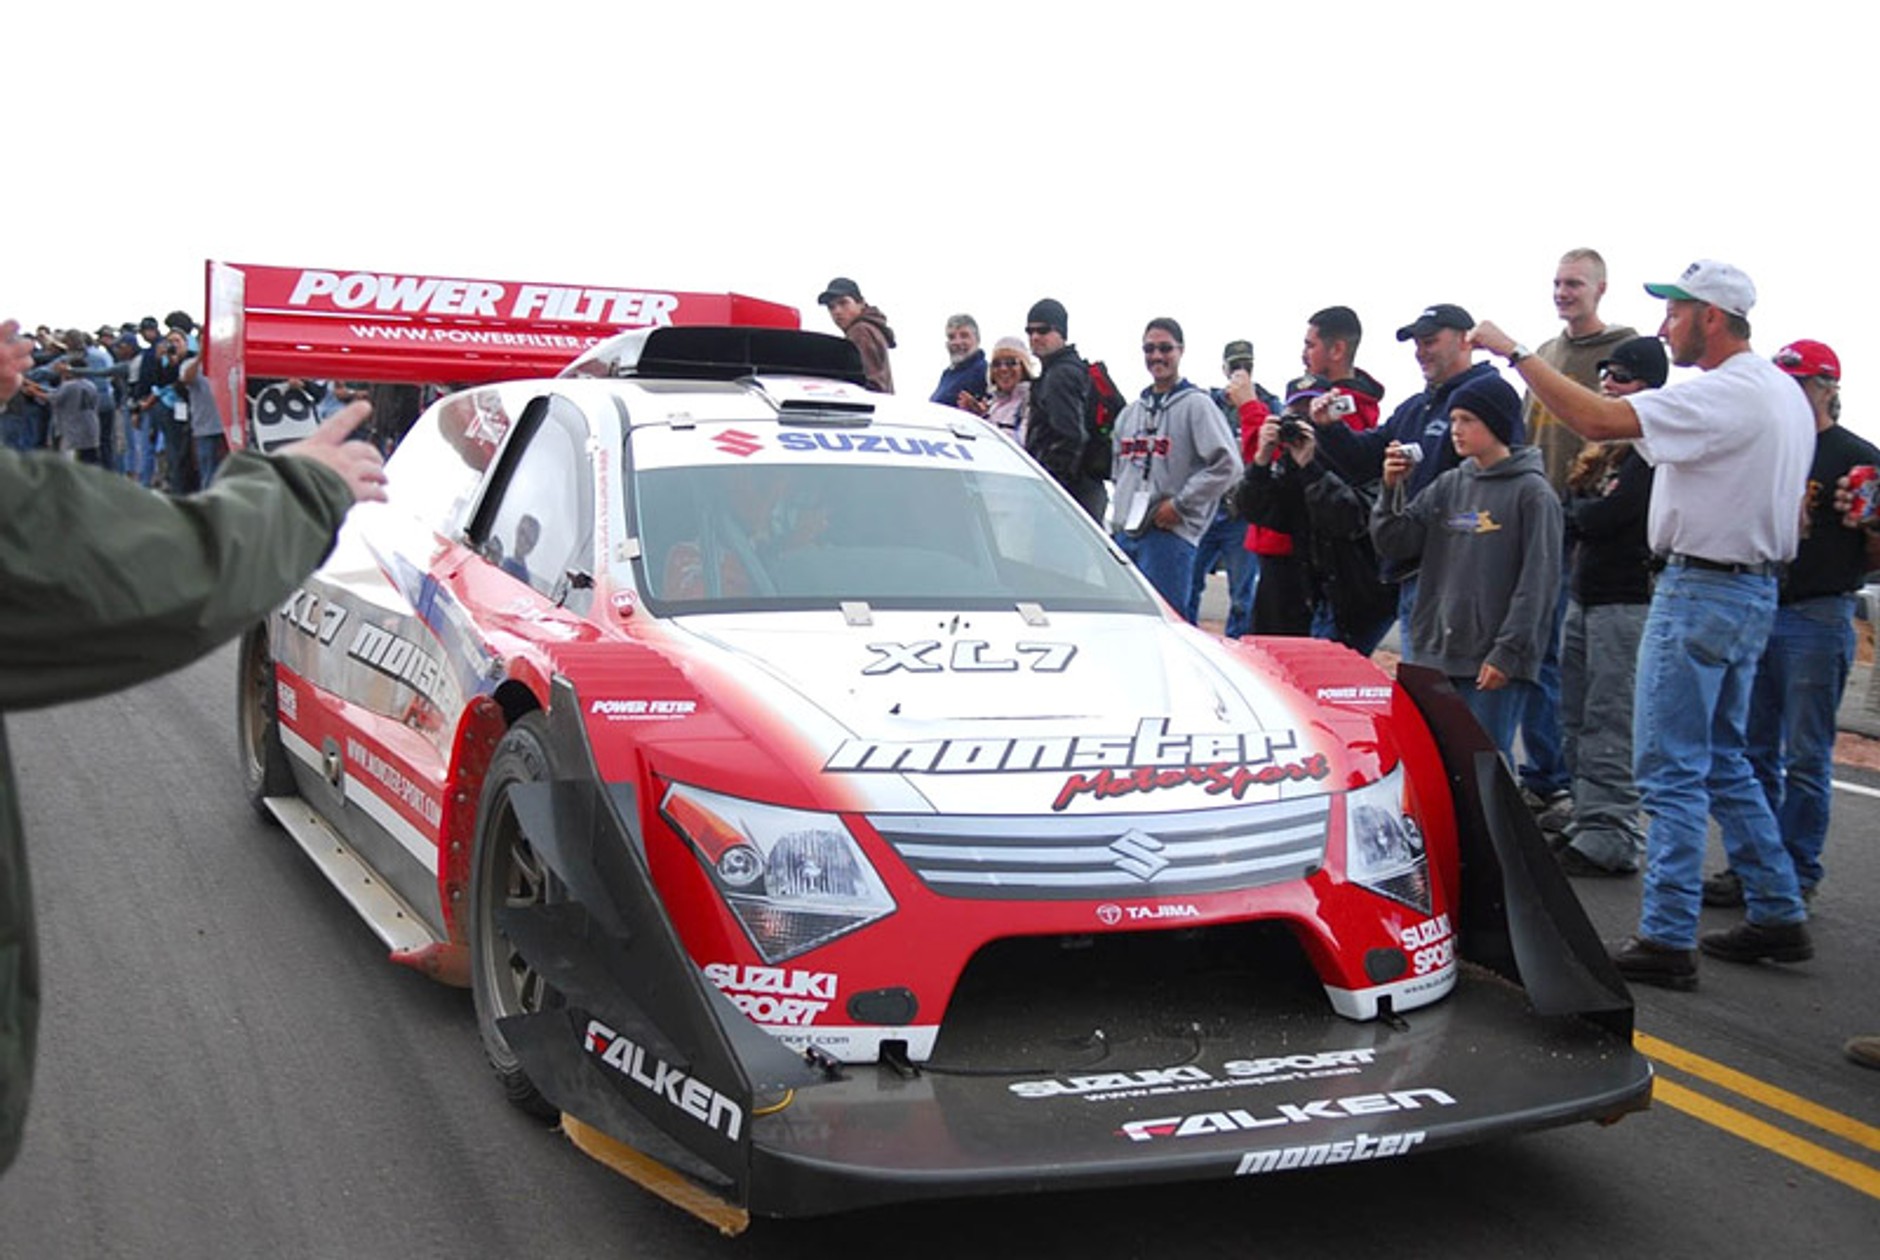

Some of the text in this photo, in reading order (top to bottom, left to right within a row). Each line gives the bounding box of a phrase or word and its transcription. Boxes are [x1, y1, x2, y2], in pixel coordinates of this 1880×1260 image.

[288, 271, 679, 326] POWER FILTER
[777, 432, 974, 461] SUZUKI
[279, 588, 348, 647] XL7
[861, 640, 1078, 676] XL7
[590, 700, 697, 714] POWER FILTER
[1125, 904, 1200, 919] TAJIMA
[704, 963, 838, 1000] SUZUKI
[584, 1019, 742, 1142] FALKEN
[1008, 1048, 1377, 1097] SUZUKI SPORT
[1114, 1088, 1458, 1142] FALKEN
[1234, 1130, 1427, 1176] monster
